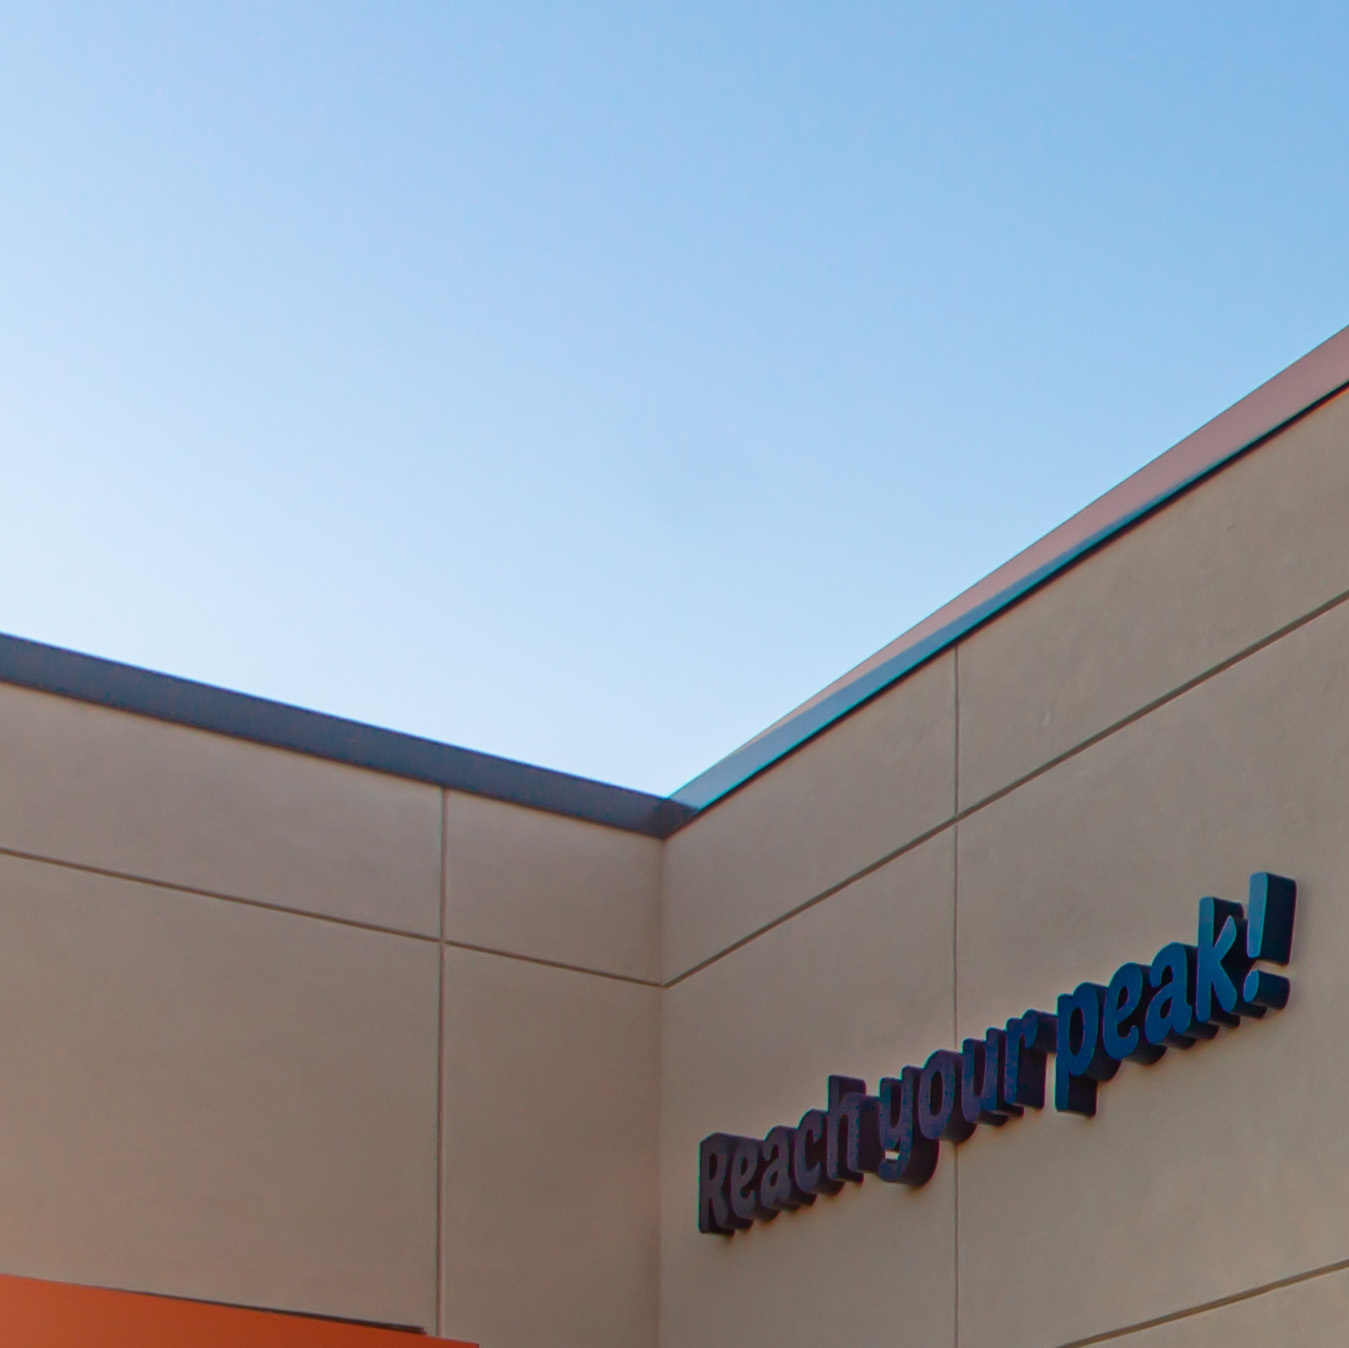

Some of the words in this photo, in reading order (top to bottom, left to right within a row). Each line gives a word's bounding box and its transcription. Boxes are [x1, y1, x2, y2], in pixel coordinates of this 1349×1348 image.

[698, 1074, 880, 1237] Reach
[878, 1009, 1056, 1187] your
[1054, 871, 1298, 1117] peak!
